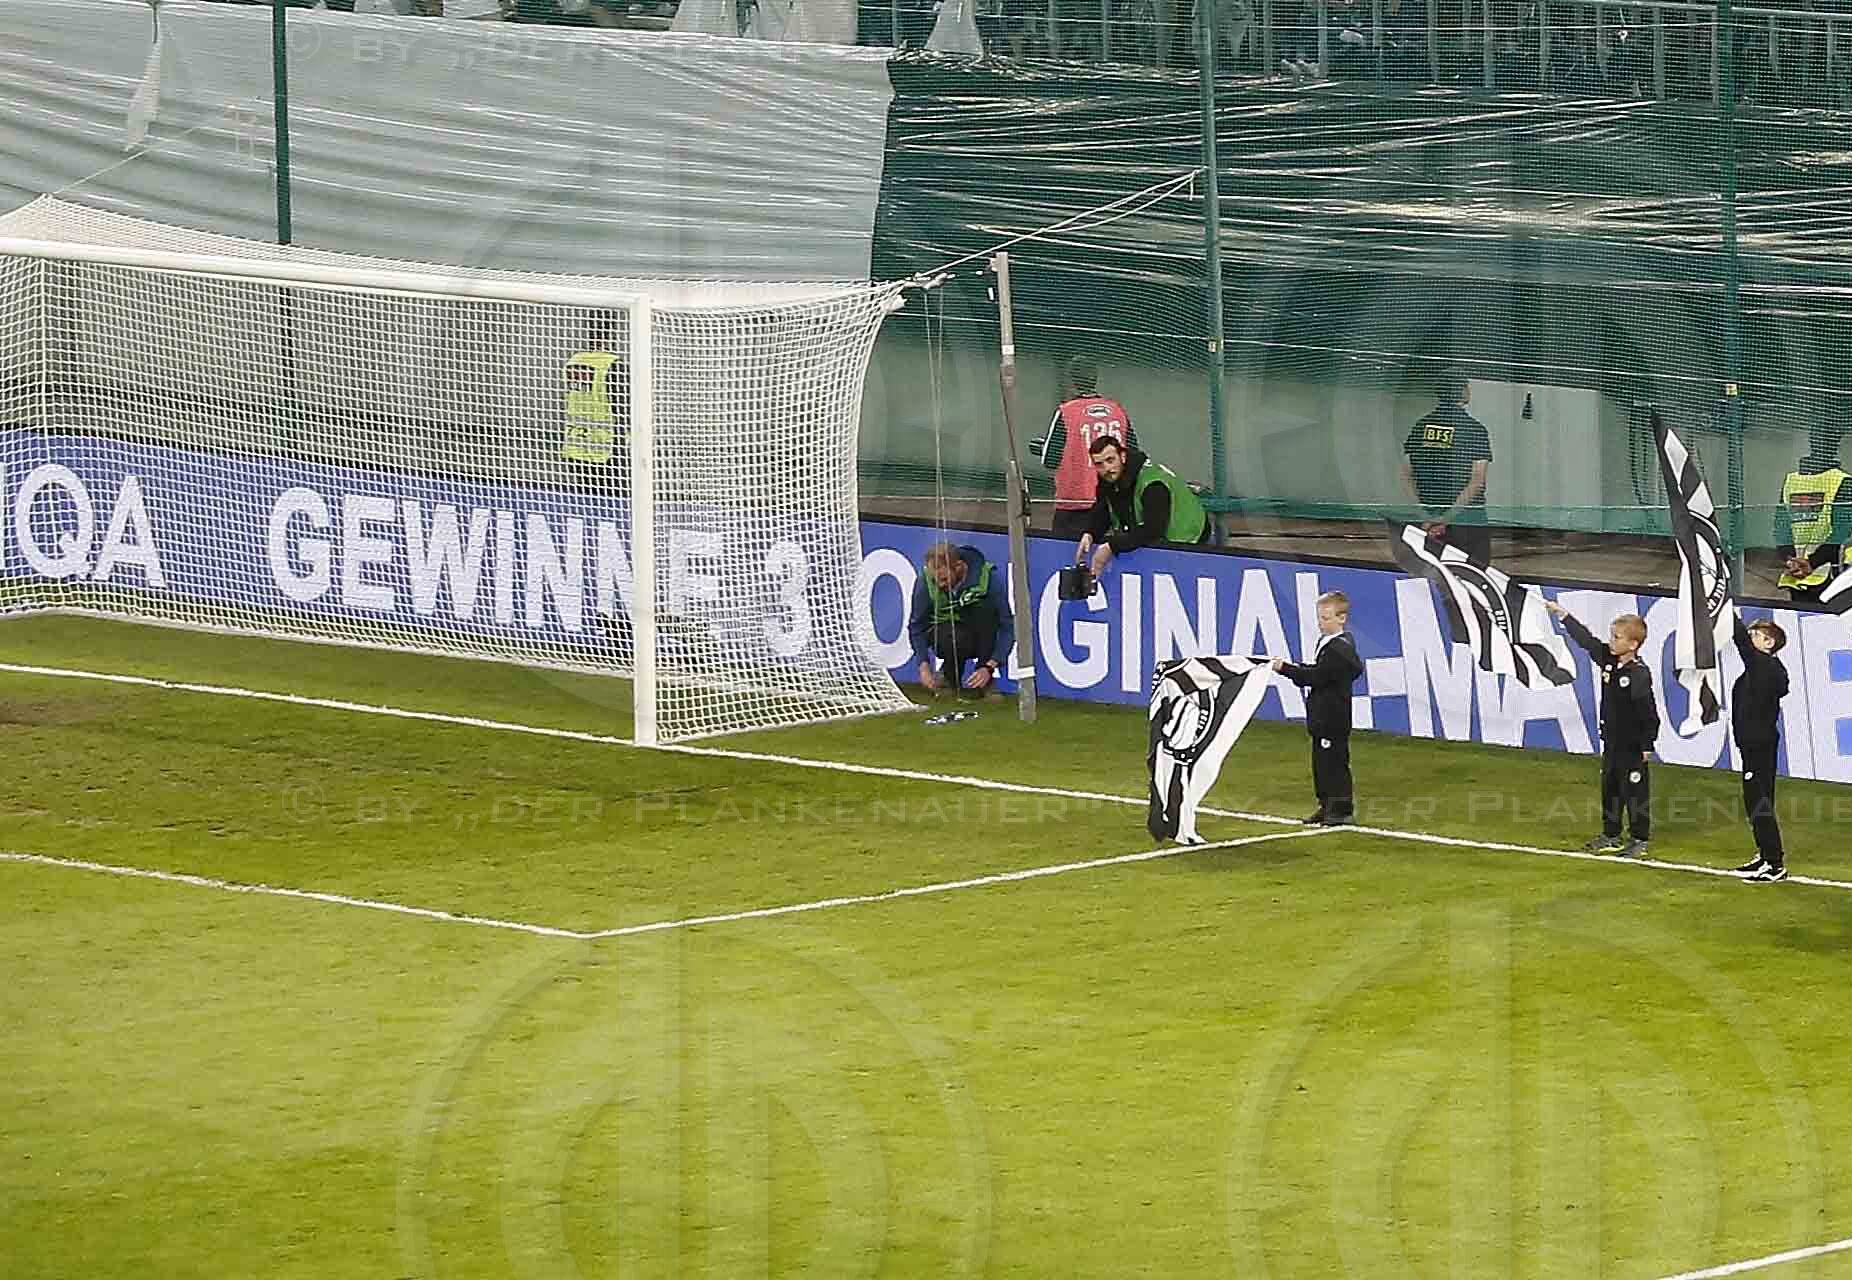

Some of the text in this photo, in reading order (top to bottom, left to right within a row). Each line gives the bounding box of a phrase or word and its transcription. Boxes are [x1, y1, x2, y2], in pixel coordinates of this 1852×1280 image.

[0, 462, 167, 590] QA
[268, 487, 725, 639] GEWINNE
[764, 539, 813, 657] 3
